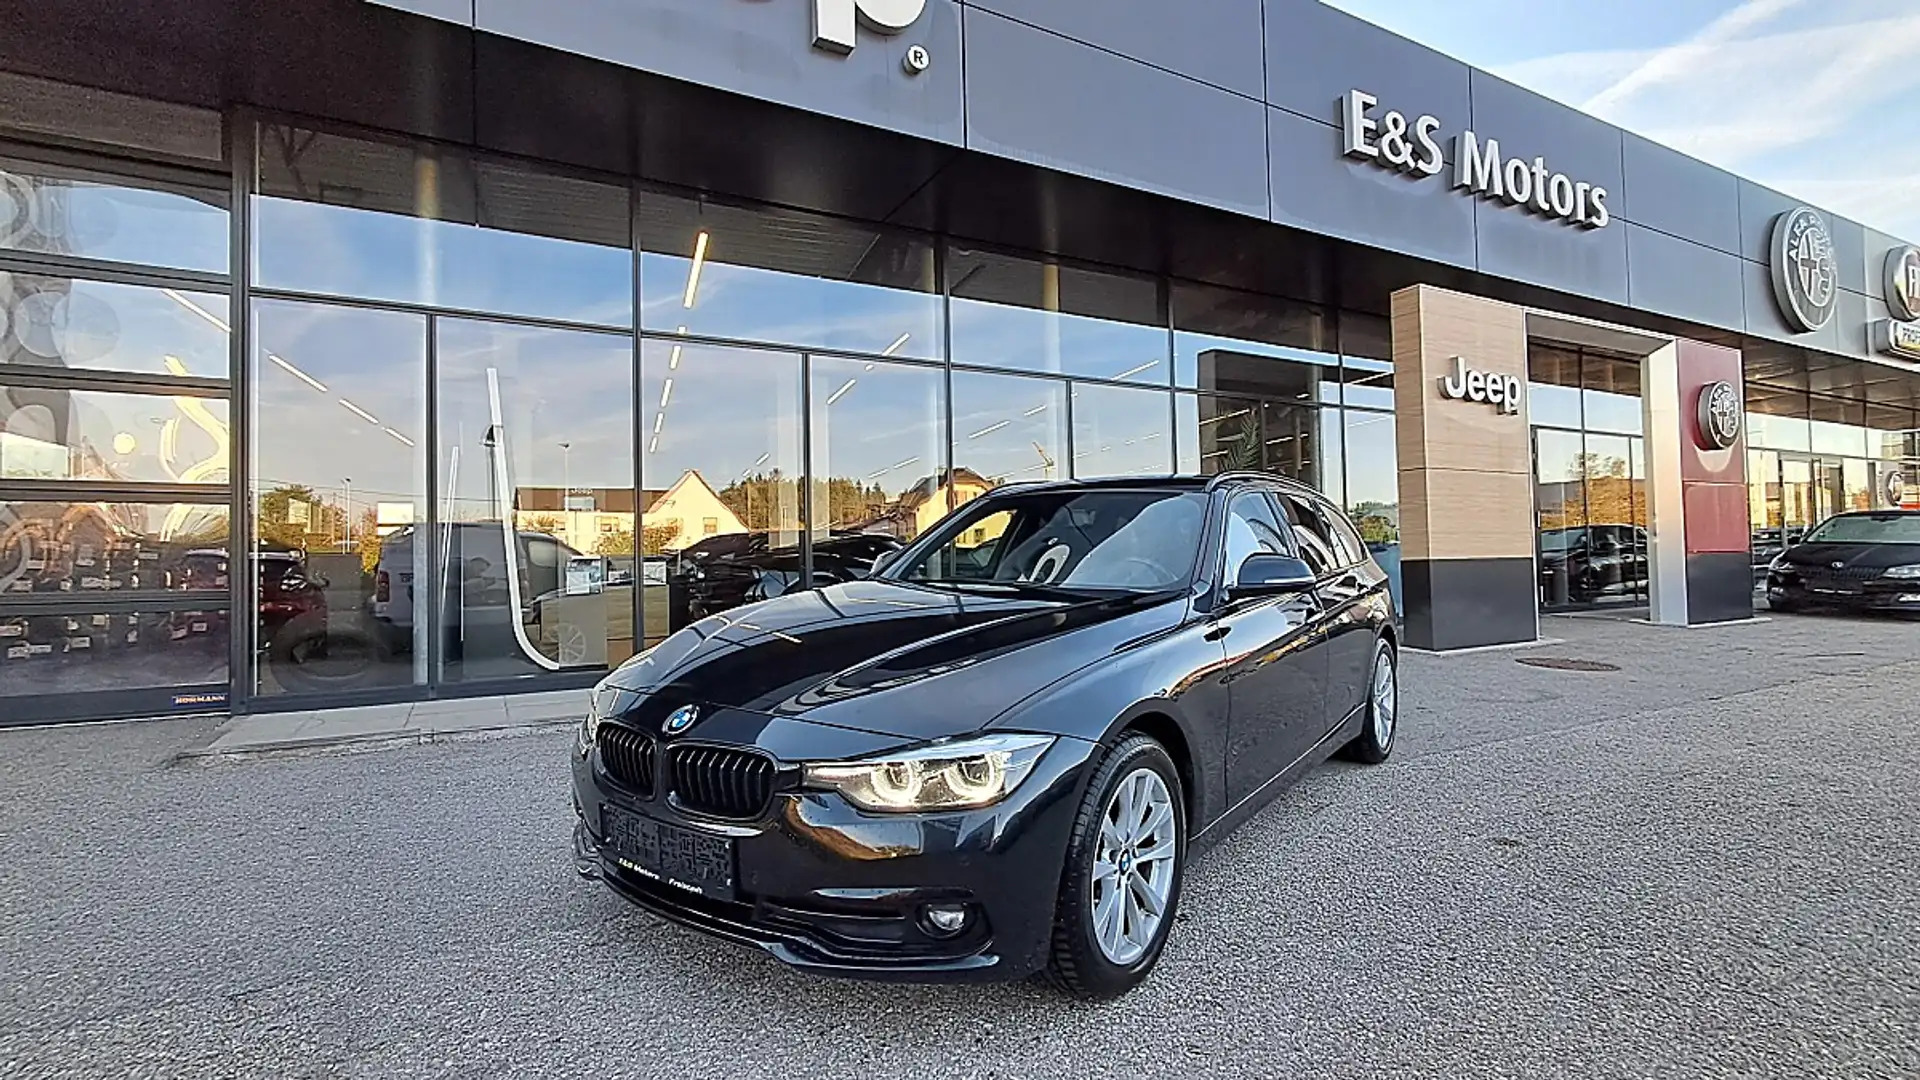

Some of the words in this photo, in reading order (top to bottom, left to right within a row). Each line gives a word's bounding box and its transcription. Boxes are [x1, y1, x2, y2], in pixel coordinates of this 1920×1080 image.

[1343, 89, 1443, 176] E&S
[1453, 130, 1610, 228] Motors
[1444, 356, 1521, 413] Jeep
